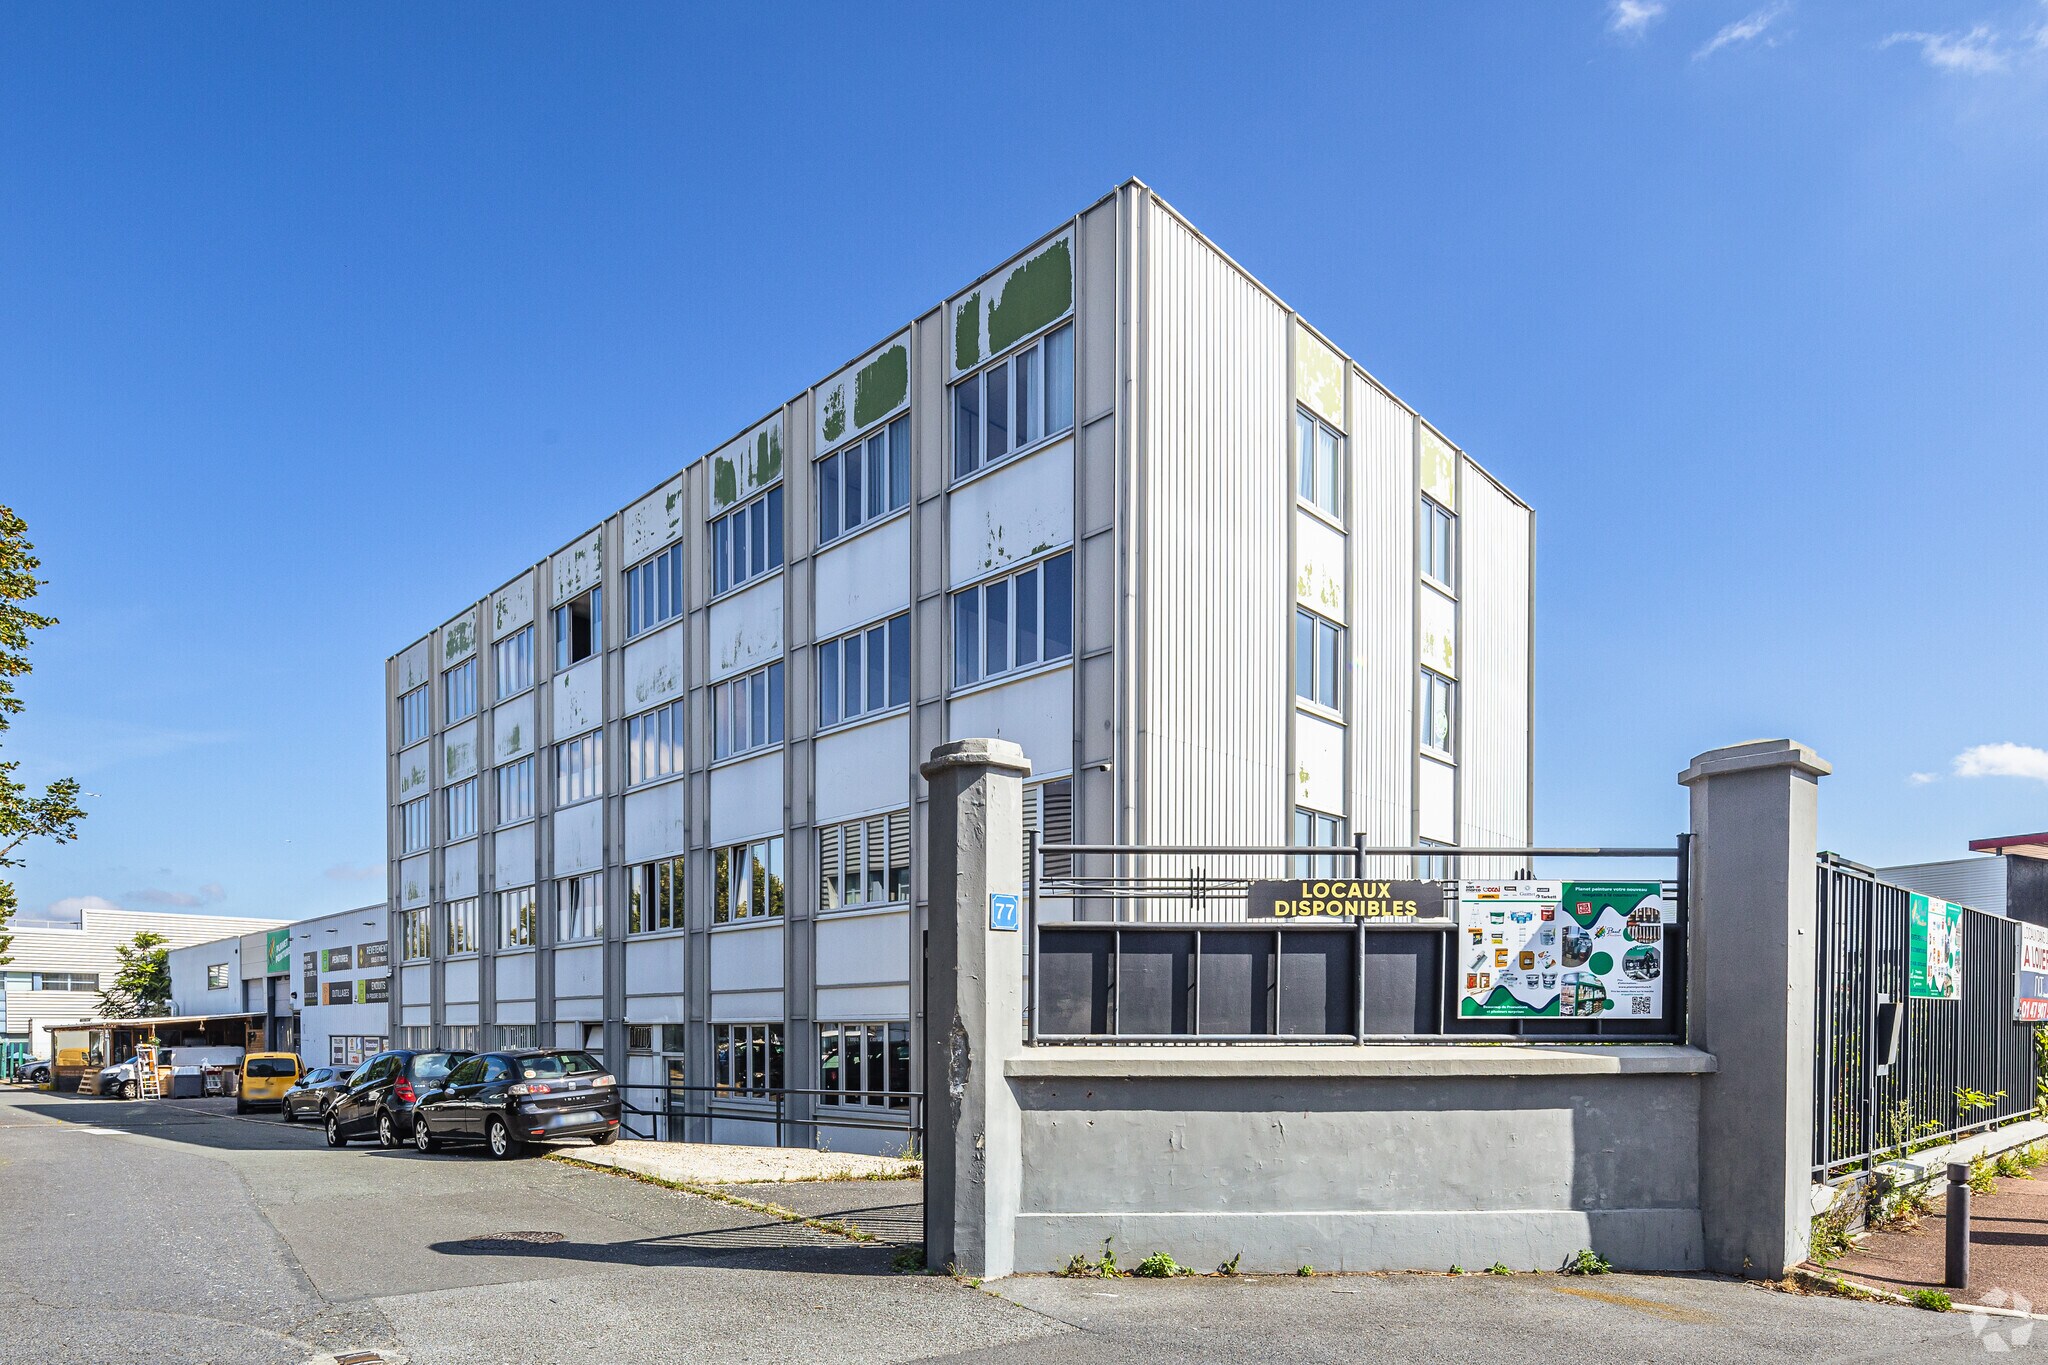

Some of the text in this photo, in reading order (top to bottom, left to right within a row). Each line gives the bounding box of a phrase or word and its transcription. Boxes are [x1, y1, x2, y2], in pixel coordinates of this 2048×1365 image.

[1302, 882, 1391, 898] LOCAUX
[995, 903, 1014, 920] 77
[1274, 900, 1418, 916] DISPONIBLES
[2024, 945, 2030, 966] A
[2022, 1001, 2030, 1018] 01
